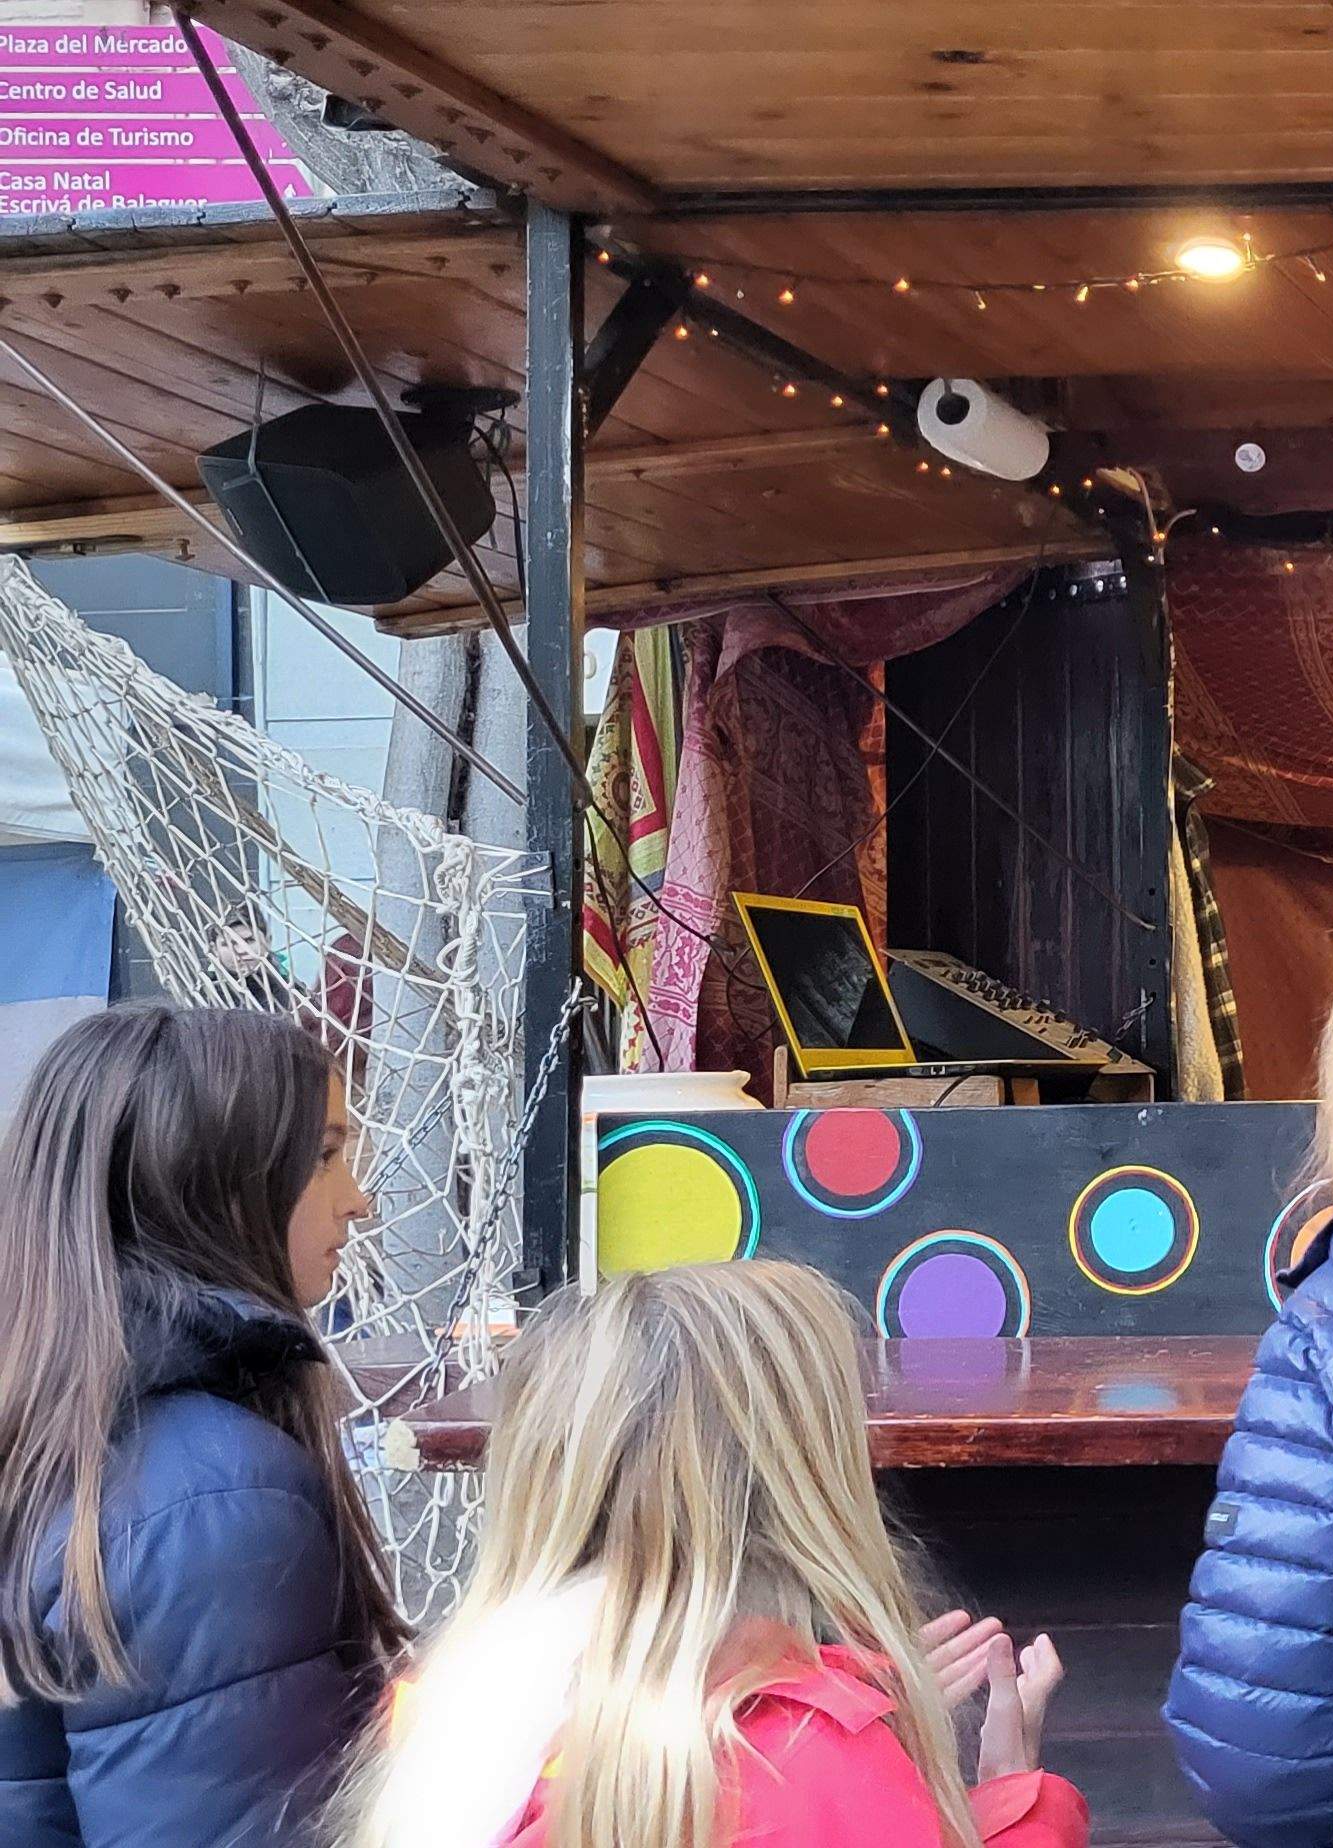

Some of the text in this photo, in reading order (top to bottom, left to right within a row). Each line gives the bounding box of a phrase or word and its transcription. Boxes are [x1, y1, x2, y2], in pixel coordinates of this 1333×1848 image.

[0, 34, 190, 54] Plaza del Mercado
[0, 80, 162, 100] Centro de Salud
[0, 126, 195, 146] Oficina de Turismo
[0, 170, 111, 191] Casa Natal
[0, 193, 72, 214] Escrivá
[78, 193, 106, 211] de
